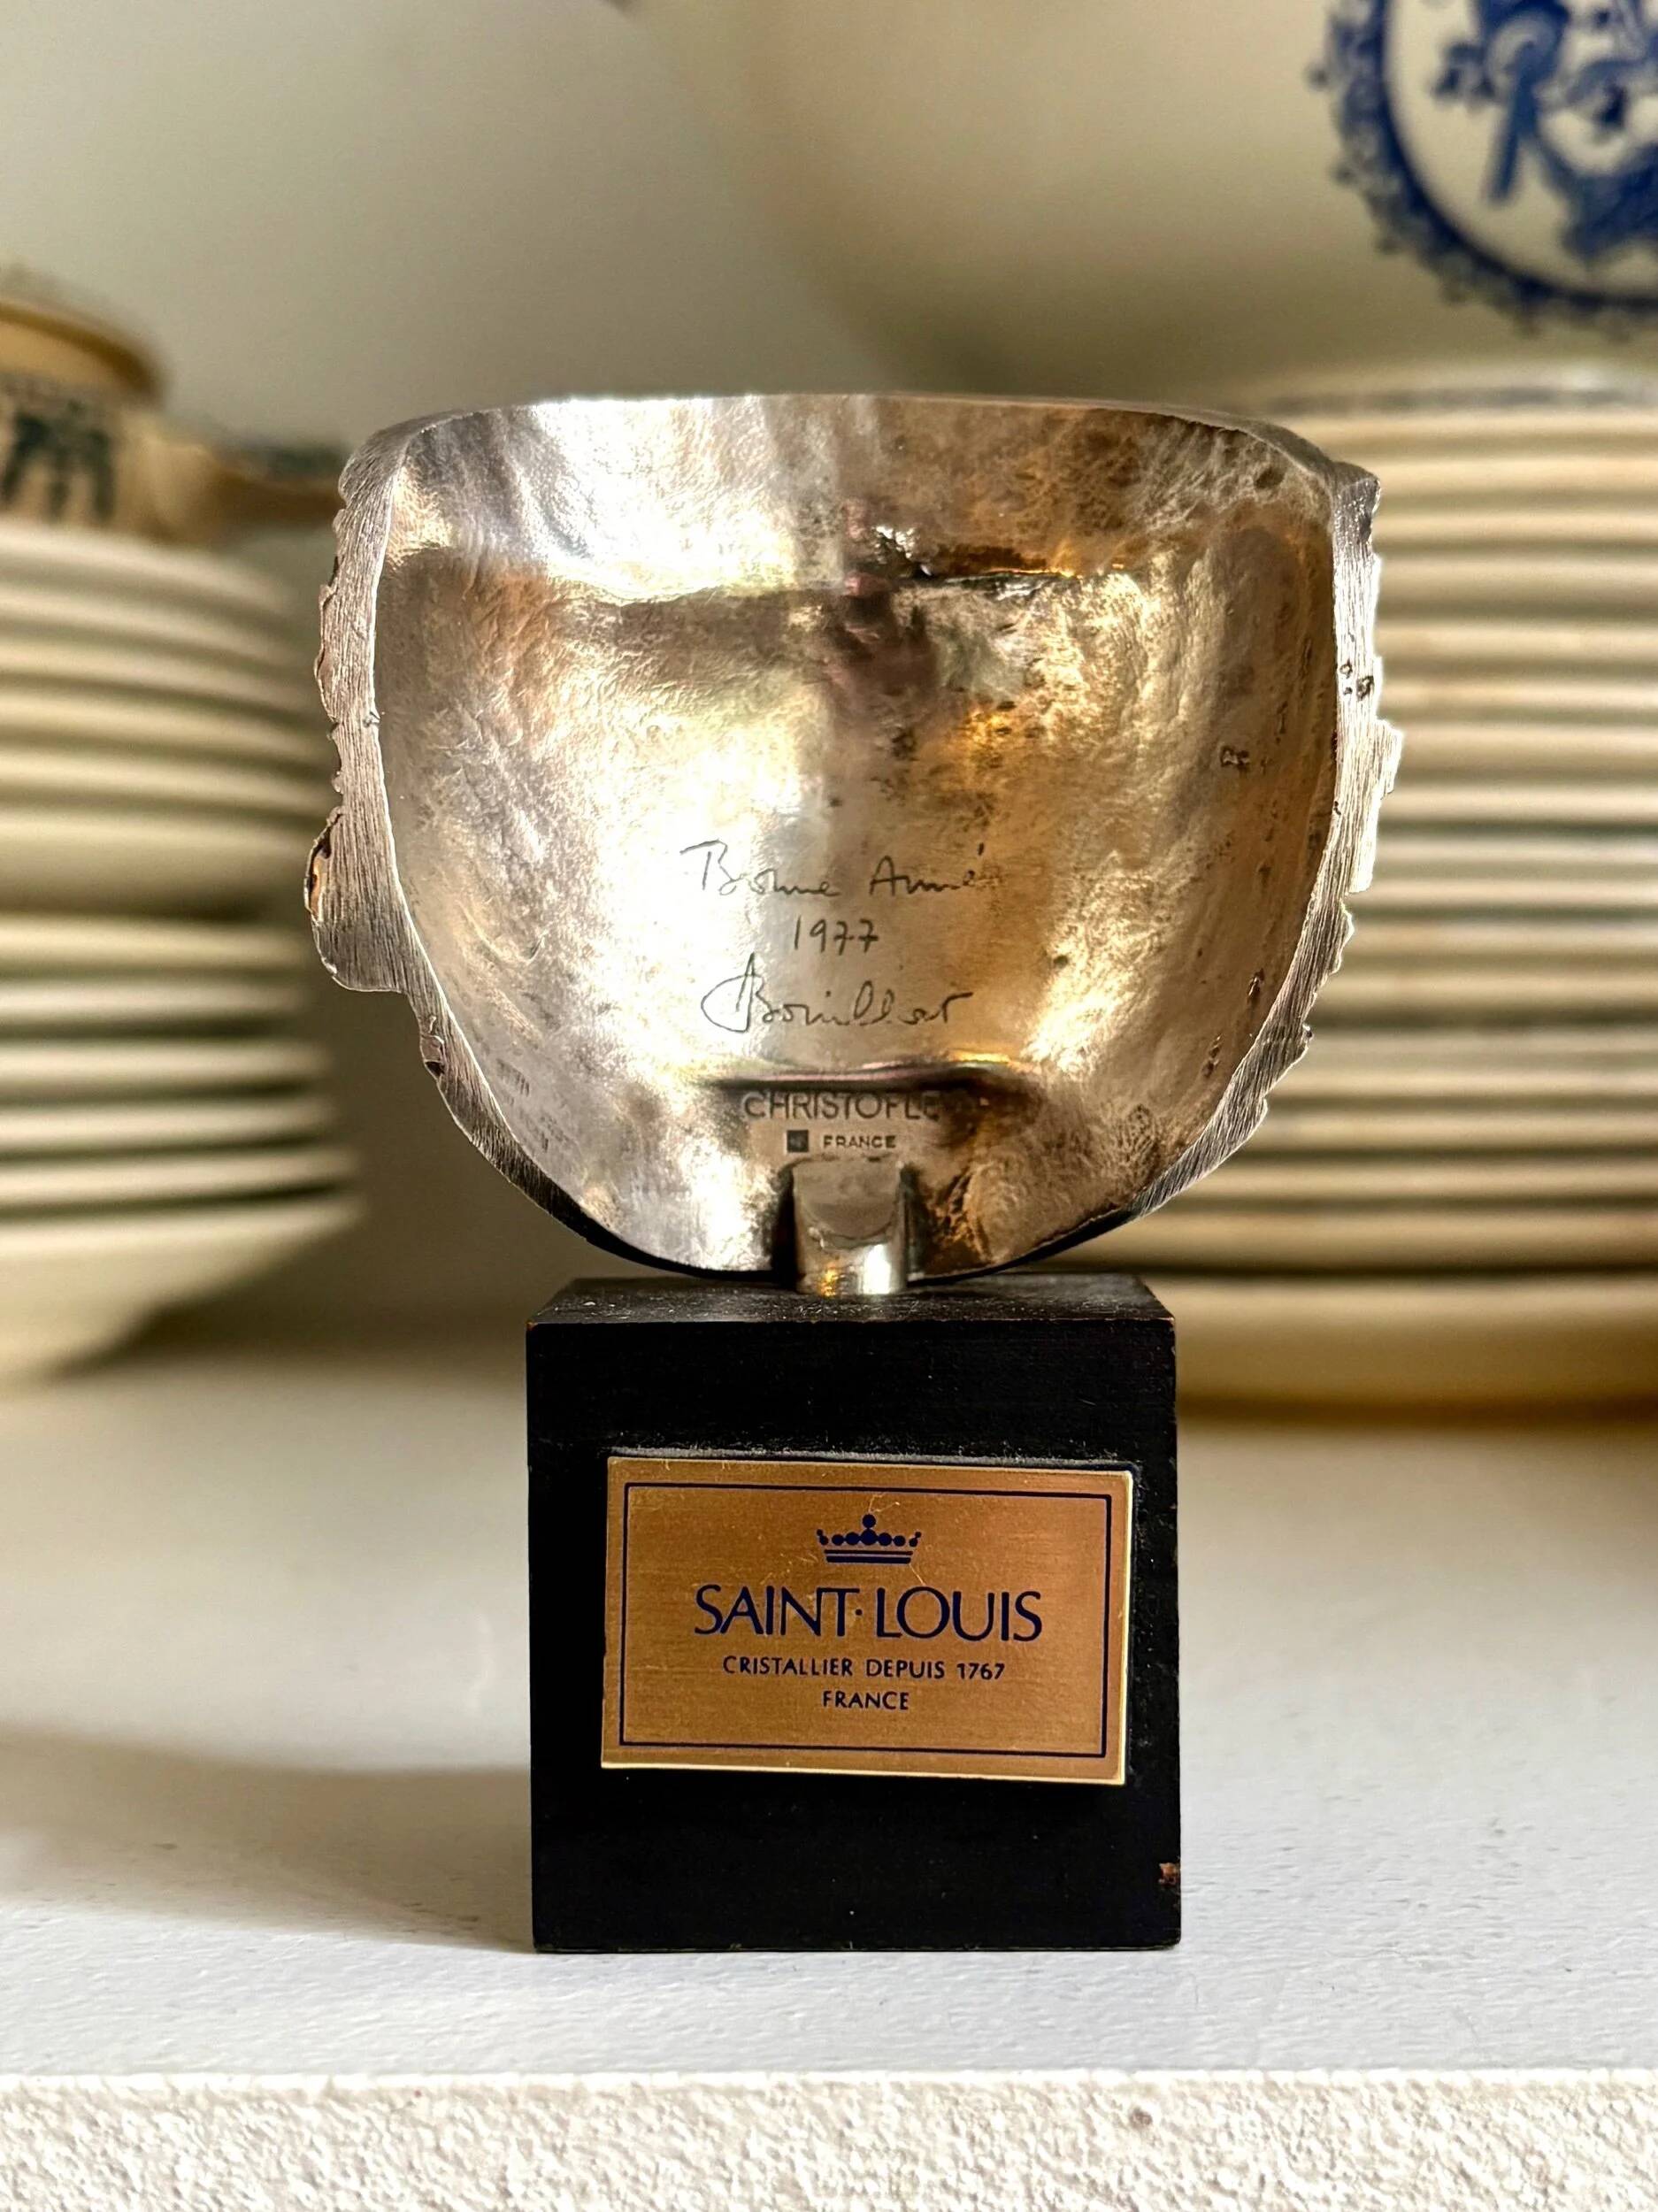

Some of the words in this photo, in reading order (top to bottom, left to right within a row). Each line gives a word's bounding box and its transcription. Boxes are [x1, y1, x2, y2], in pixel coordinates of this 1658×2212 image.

[793, 915, 879, 956] 1977
[742, 1090, 940, 1121] CHRISTOFLE
[823, 1134, 897, 1149] FRANCE
[723, 1655, 853, 1677] CRISTALLIER
[866, 1659, 945, 1679] DEPUIS
[956, 1663, 1005, 1680] 1767
[823, 1690, 909, 1710] FRANCE
